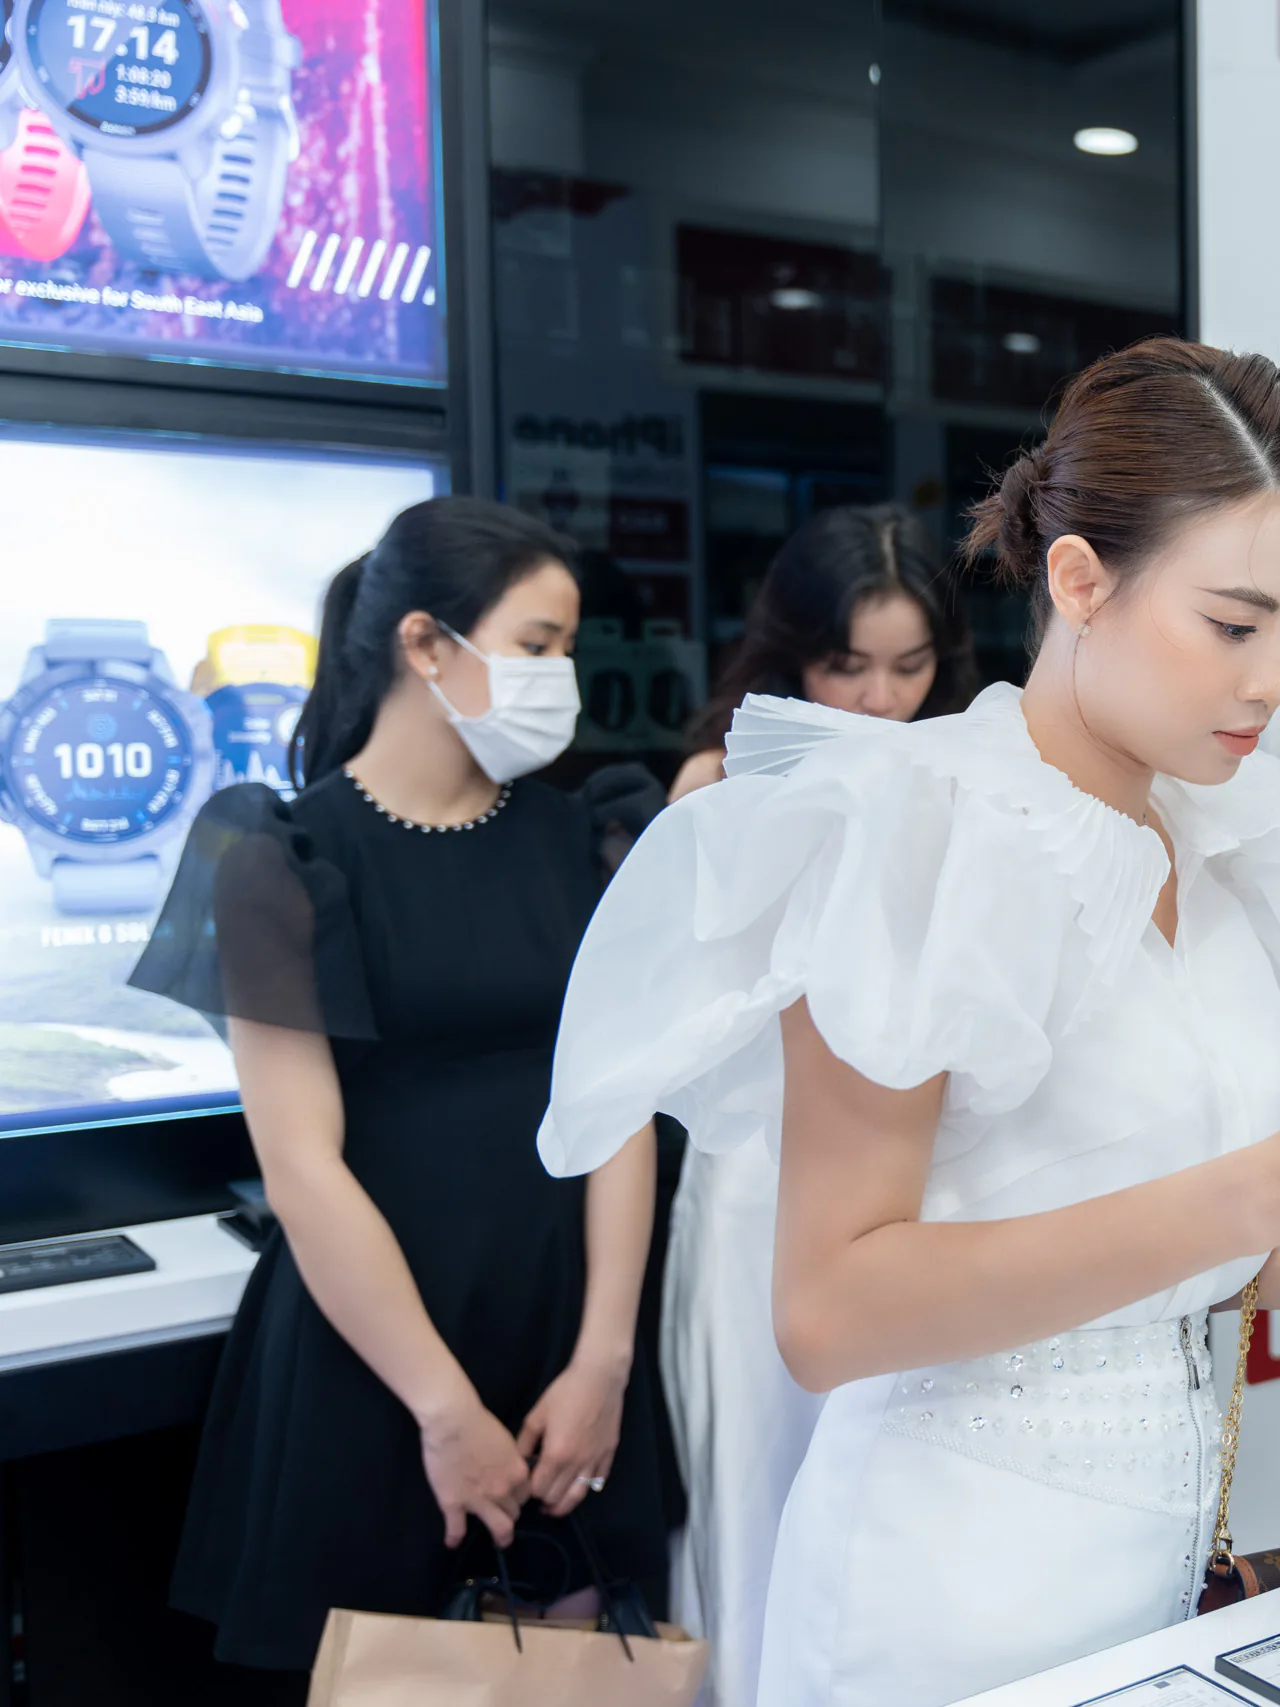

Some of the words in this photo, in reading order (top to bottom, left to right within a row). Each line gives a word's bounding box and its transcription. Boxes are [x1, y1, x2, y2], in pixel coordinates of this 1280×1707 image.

[67, 15, 179, 65] 17.14
[15, 280, 100, 304] exclusive
[102, 285, 129, 307] for
[130, 290, 183, 313] South
[184, 295, 223, 318] East
[224, 300, 264, 323] Asia
